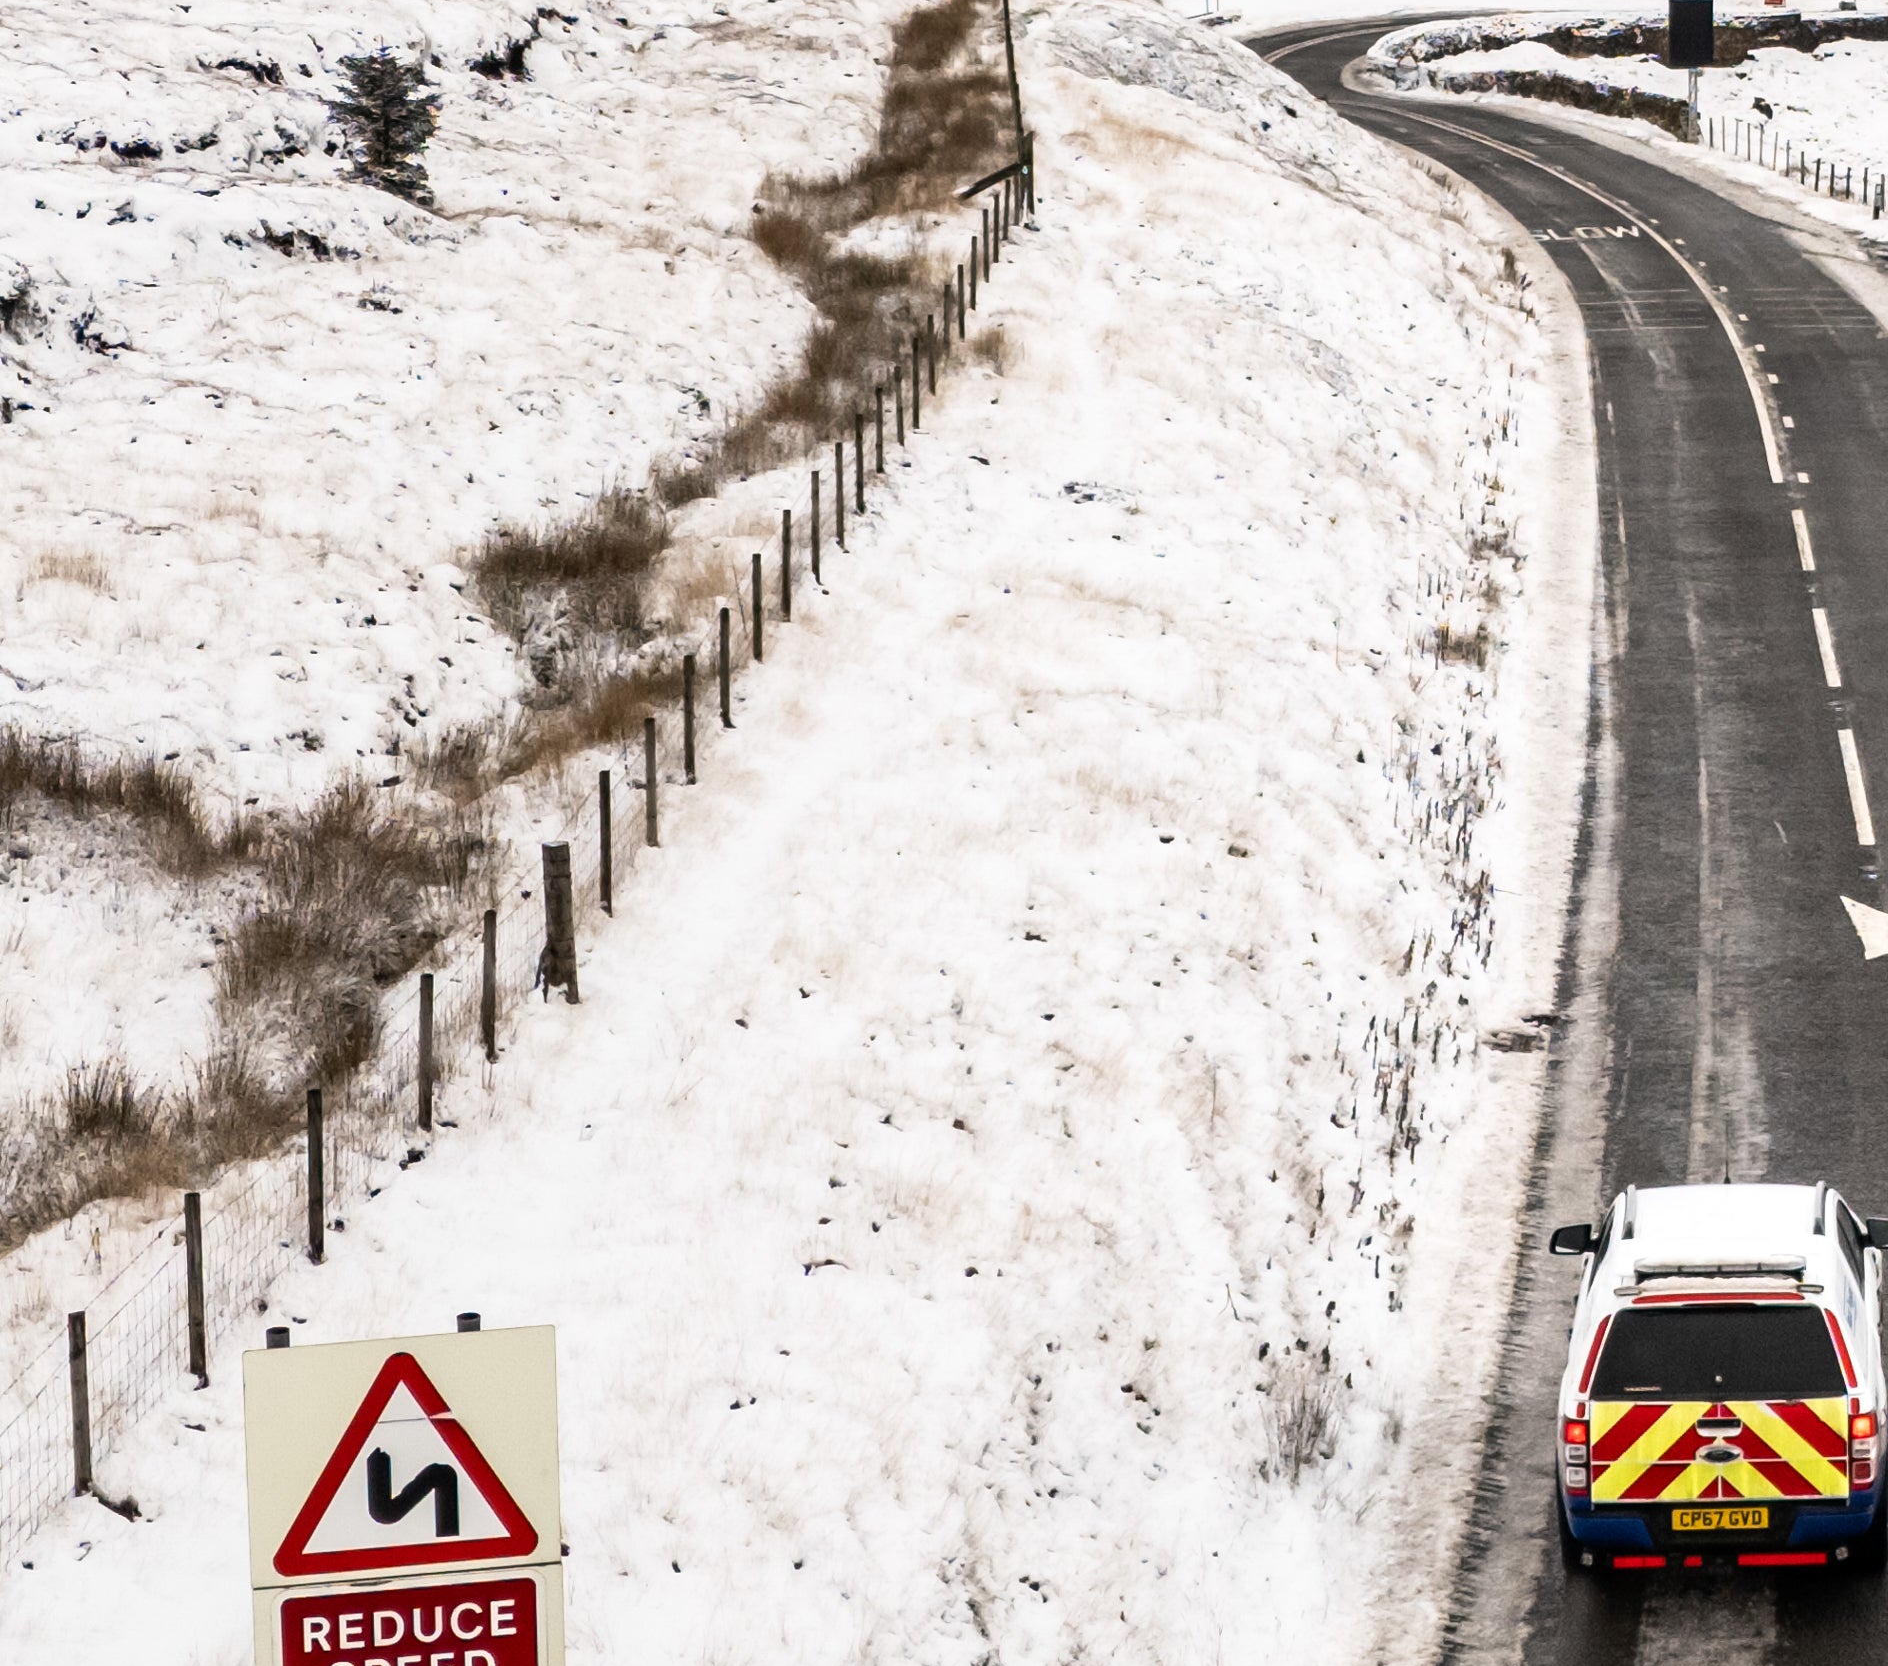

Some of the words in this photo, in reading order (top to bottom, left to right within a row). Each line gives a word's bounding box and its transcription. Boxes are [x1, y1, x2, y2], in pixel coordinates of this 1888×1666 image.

[1530, 225, 1640, 241] SLOW
[1680, 1511, 1724, 1527] CP67
[1729, 1510, 1762, 1526] GVD
[302, 1599, 517, 1653] REDUCE
